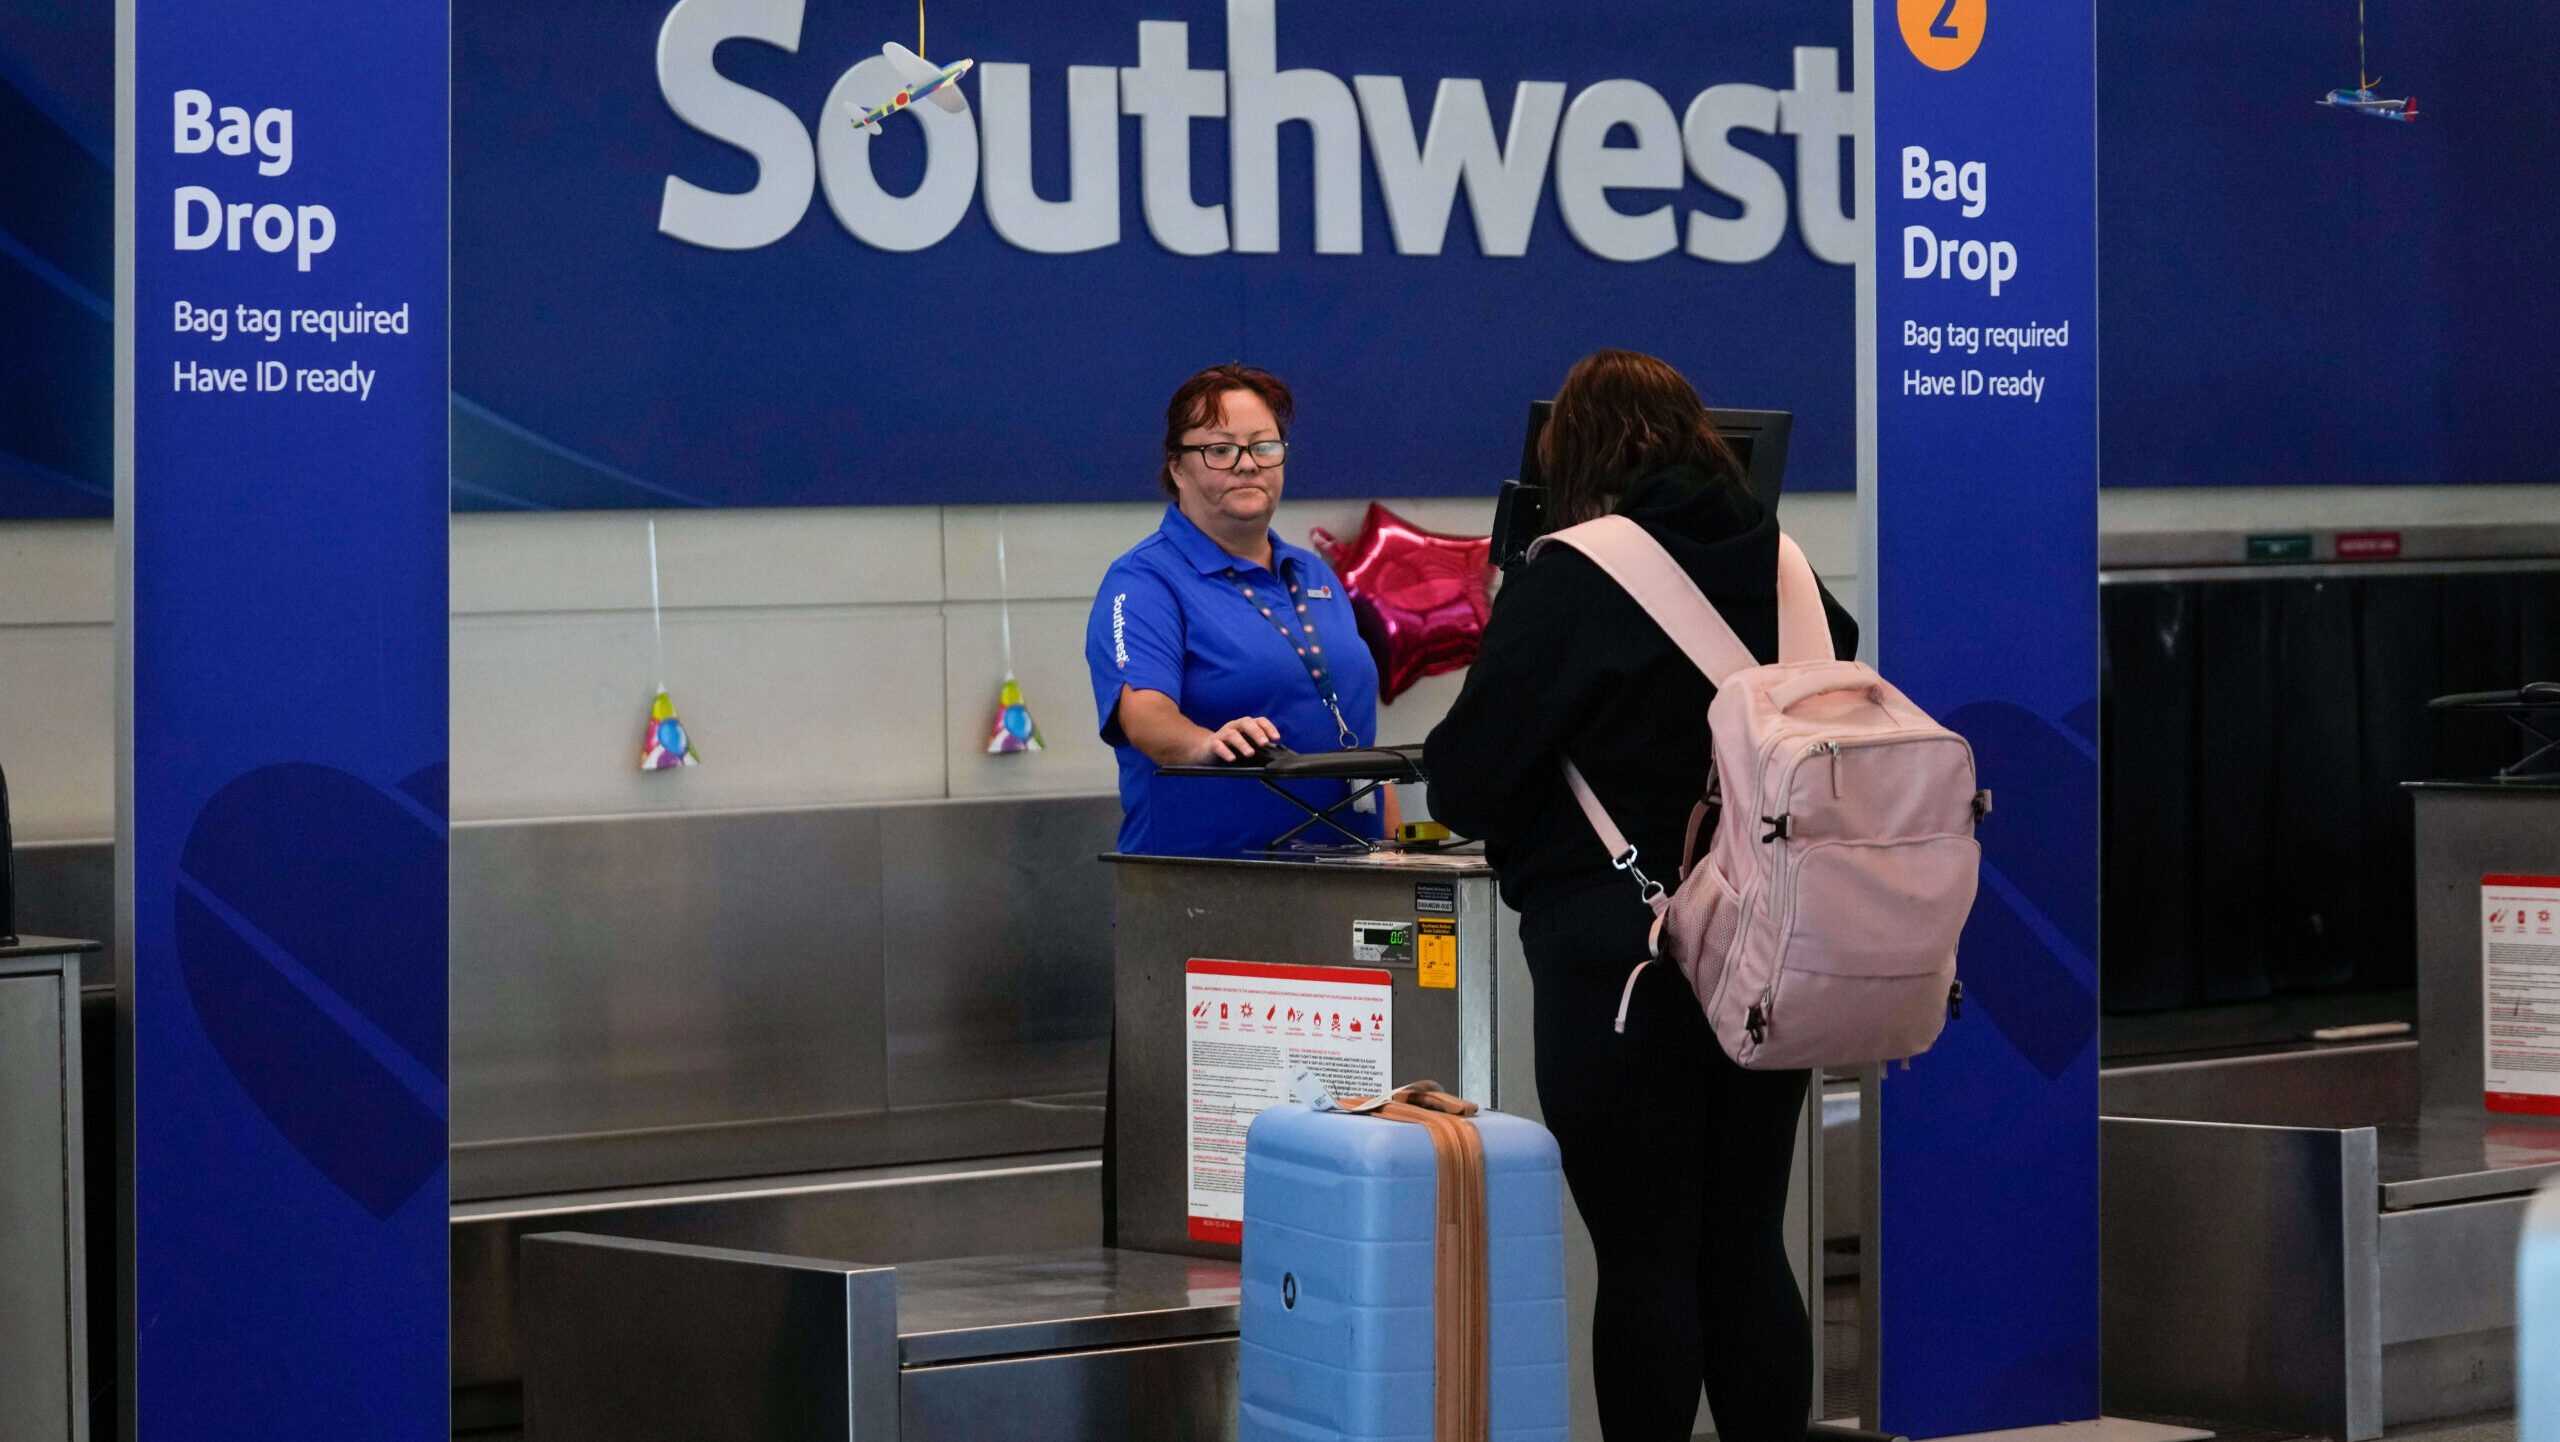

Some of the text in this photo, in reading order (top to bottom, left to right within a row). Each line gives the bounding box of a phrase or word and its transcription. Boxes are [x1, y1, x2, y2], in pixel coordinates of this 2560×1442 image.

[1929, 0, 1958, 39] 2
[173, 89, 293, 177] Bag
[656, 0, 1856, 266] Southwest
[1902, 145, 1987, 219] Bag
[174, 185, 337, 272] Drop
[1903, 225, 2018, 297] Drop
[174, 300, 409, 342] Bag tag required
[1903, 319, 2069, 355] Bag tag required
[174, 360, 376, 402] Have ID ready
[1903, 369, 2045, 403] Have ID ready
[1113, 593, 1129, 663] Southwest
